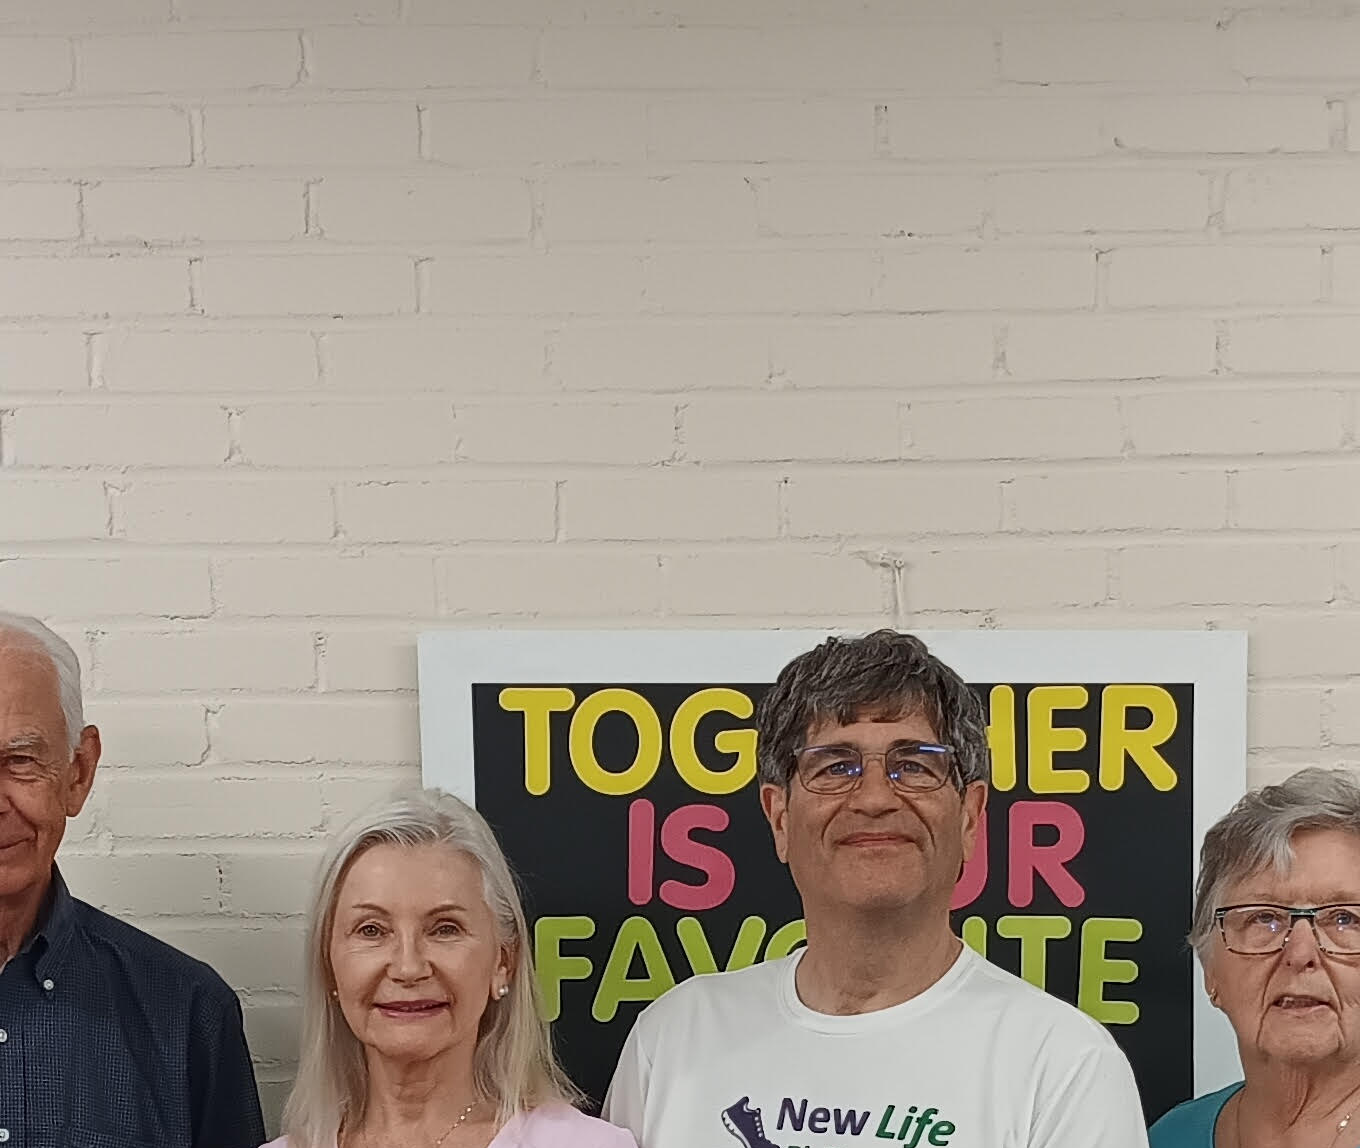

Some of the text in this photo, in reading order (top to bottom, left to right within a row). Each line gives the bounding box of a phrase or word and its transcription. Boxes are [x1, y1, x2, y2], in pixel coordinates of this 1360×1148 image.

[499, 684, 1178, 795] TOGER
[628, 798, 736, 911] IS
[535, 915, 1143, 1025] FAVTE
[776, 1097, 871, 1136] New
